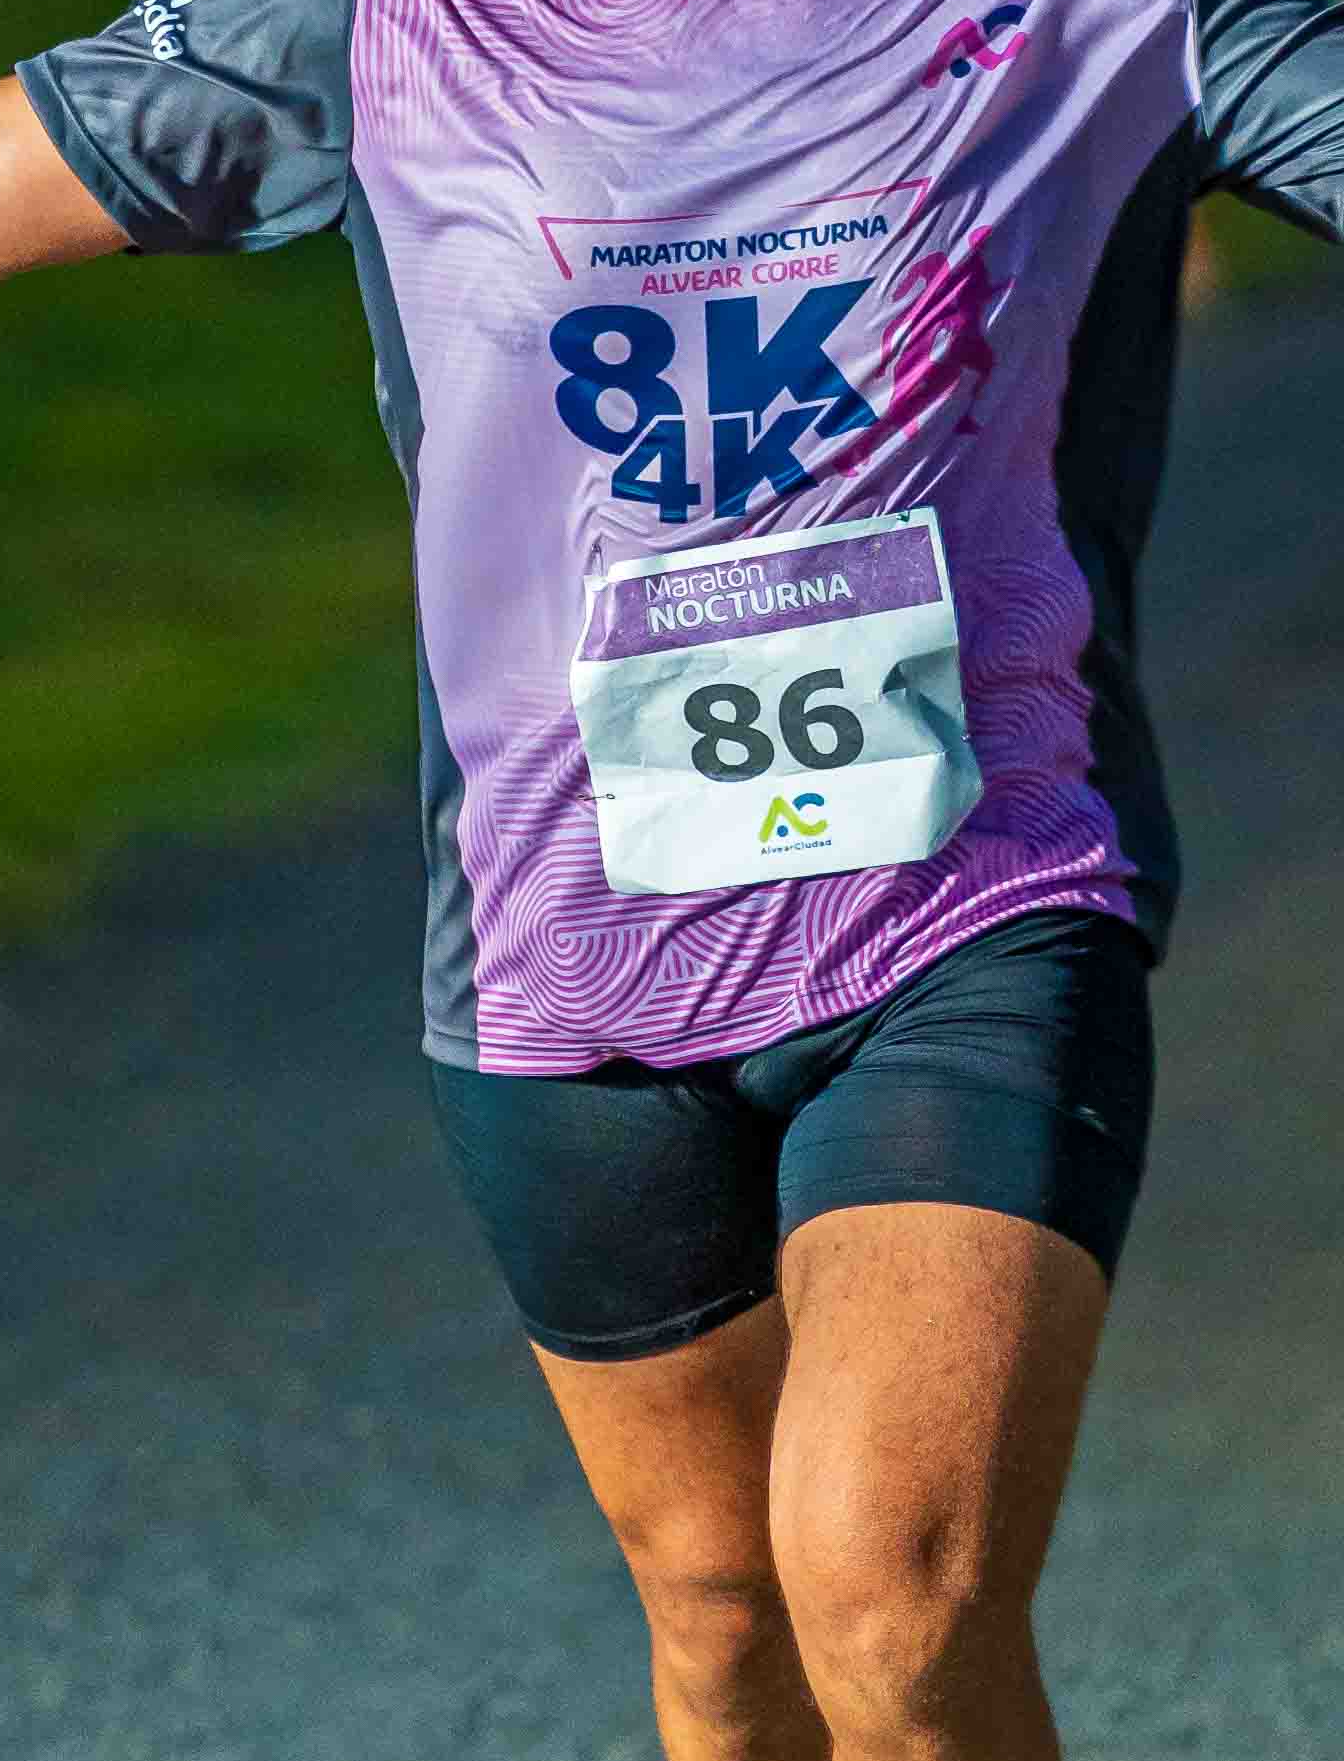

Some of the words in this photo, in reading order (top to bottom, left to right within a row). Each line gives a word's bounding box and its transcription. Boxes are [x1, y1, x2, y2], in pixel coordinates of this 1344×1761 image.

[590, 236, 728, 269] MARATON
[737, 214, 889, 258] NOCTURNA
[640, 266, 743, 297] ALVEAR
[751, 253, 840, 285] CORRE
[549, 276, 881, 457] 8K
[611, 400, 834, 525] 4K
[644, 559, 765, 603] Maratón
[647, 571, 854, 634] NOCTURNA
[682, 667, 865, 783] 86
